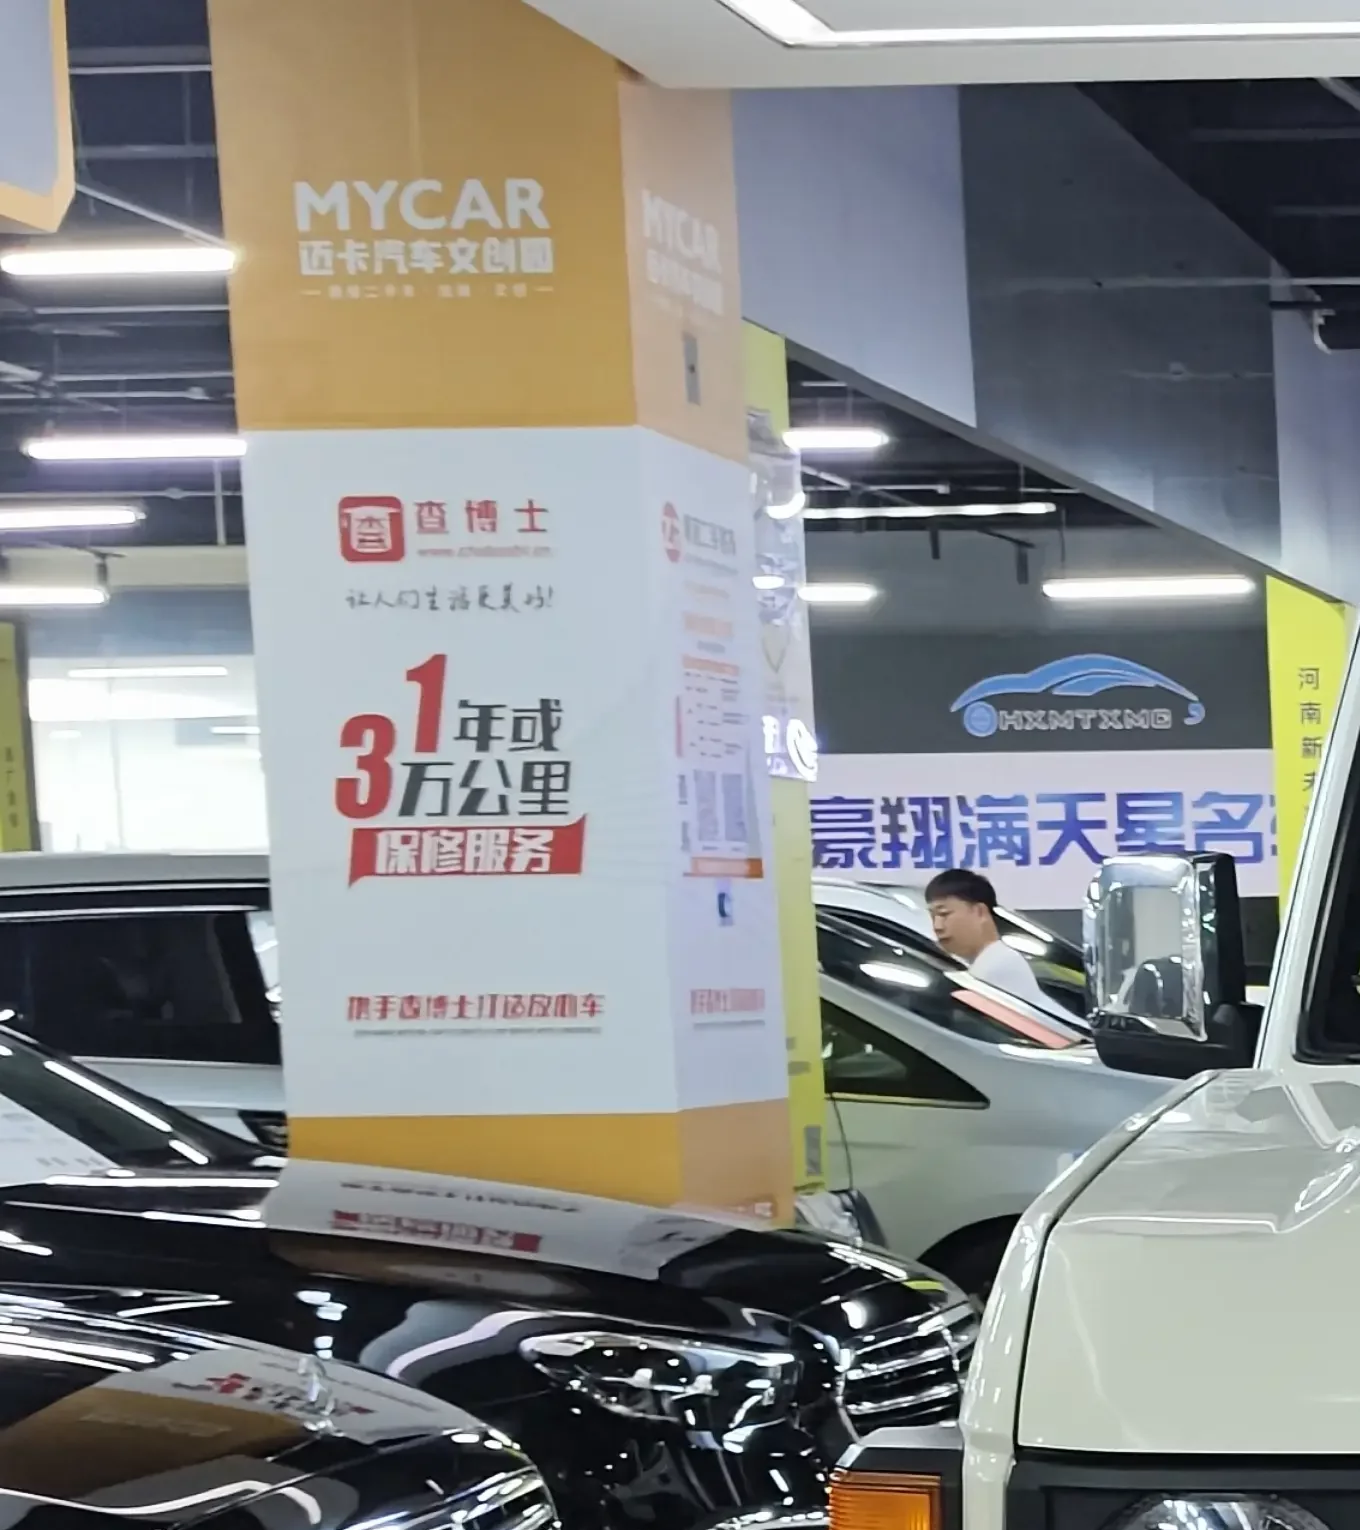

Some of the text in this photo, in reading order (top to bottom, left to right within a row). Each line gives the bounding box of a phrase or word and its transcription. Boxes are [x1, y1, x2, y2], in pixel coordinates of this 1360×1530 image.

[294, 178, 551, 232] MYCAR
[334, 713, 571, 819] 3万公里
[374, 829, 554, 874] 保修服务
[810, 791, 1277, 868] 豪翔满天星名
